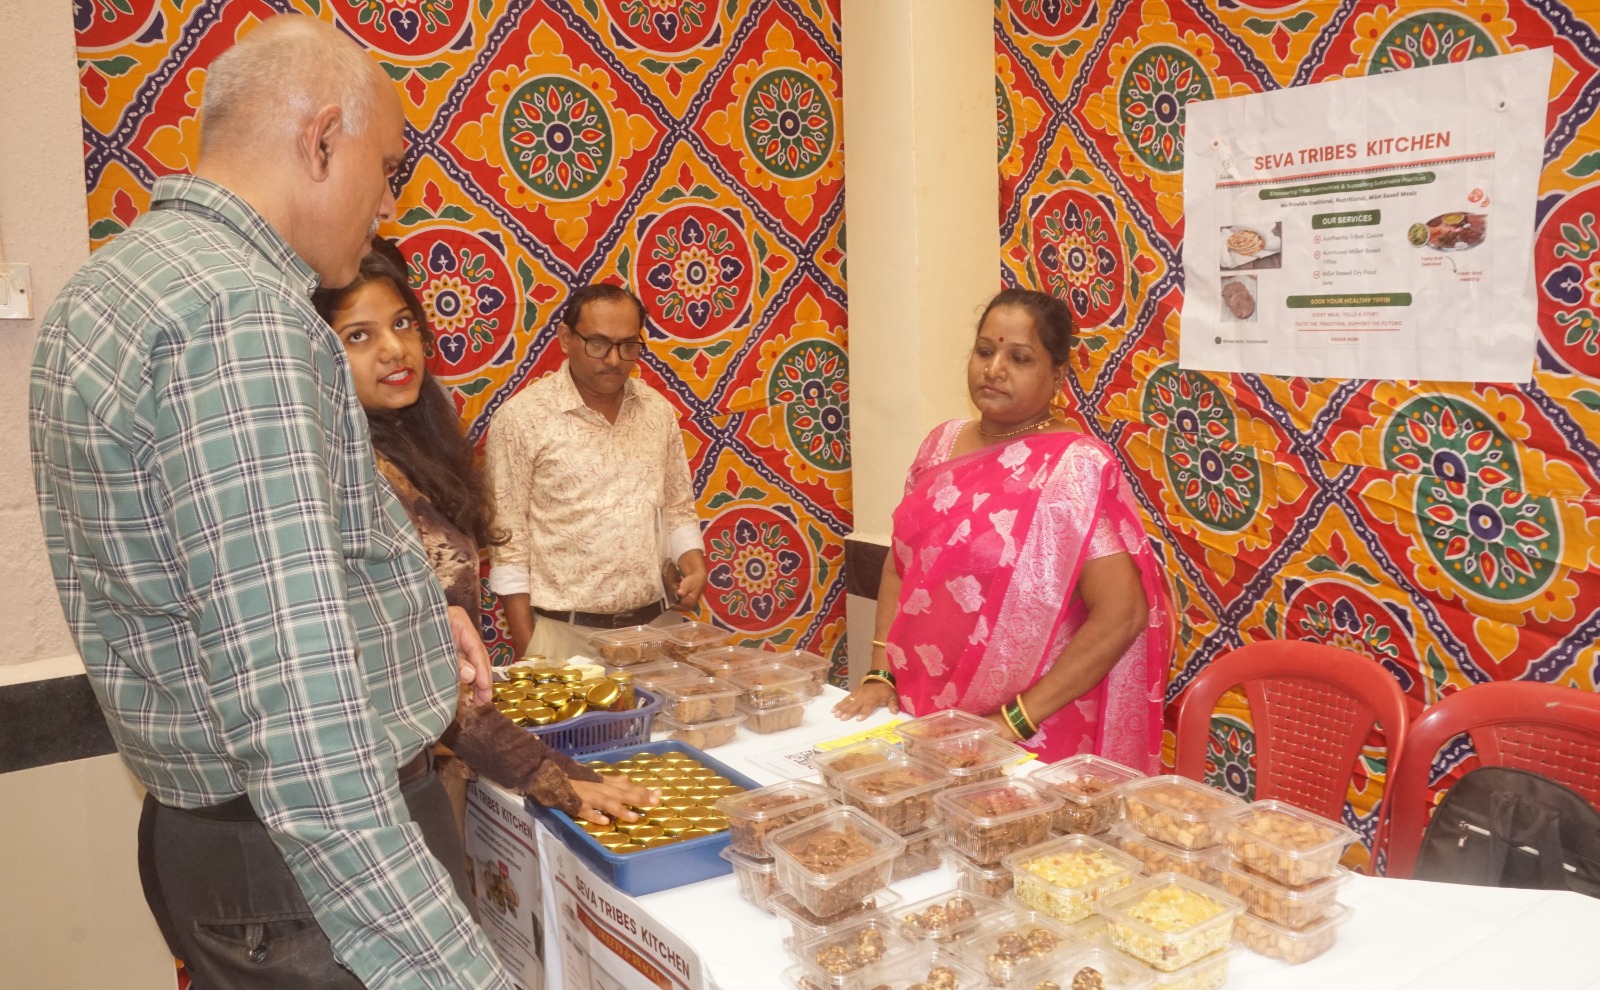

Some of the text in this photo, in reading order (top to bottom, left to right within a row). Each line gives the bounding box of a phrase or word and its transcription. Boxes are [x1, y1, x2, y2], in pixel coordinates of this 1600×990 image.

[1254, 131, 1451, 171] SEVA TRIBES KITCHEN
[1311, 185, 1340, 193] Communities
[1346, 181, 1374, 189] Supporting
[1374, 178, 1401, 186] Sustainable
[1402, 175, 1427, 183] Practices
[1322, 214, 1373, 225] OUR SERVICES
[479, 789, 500, 816] TRIBES
[501, 806, 533, 840] KITCHEN
[575, 875, 598, 909] SEVA
[598, 896, 637, 935] TRIBES
[641, 926, 691, 980] KITCHEN
[624, 950, 631, 960] &
